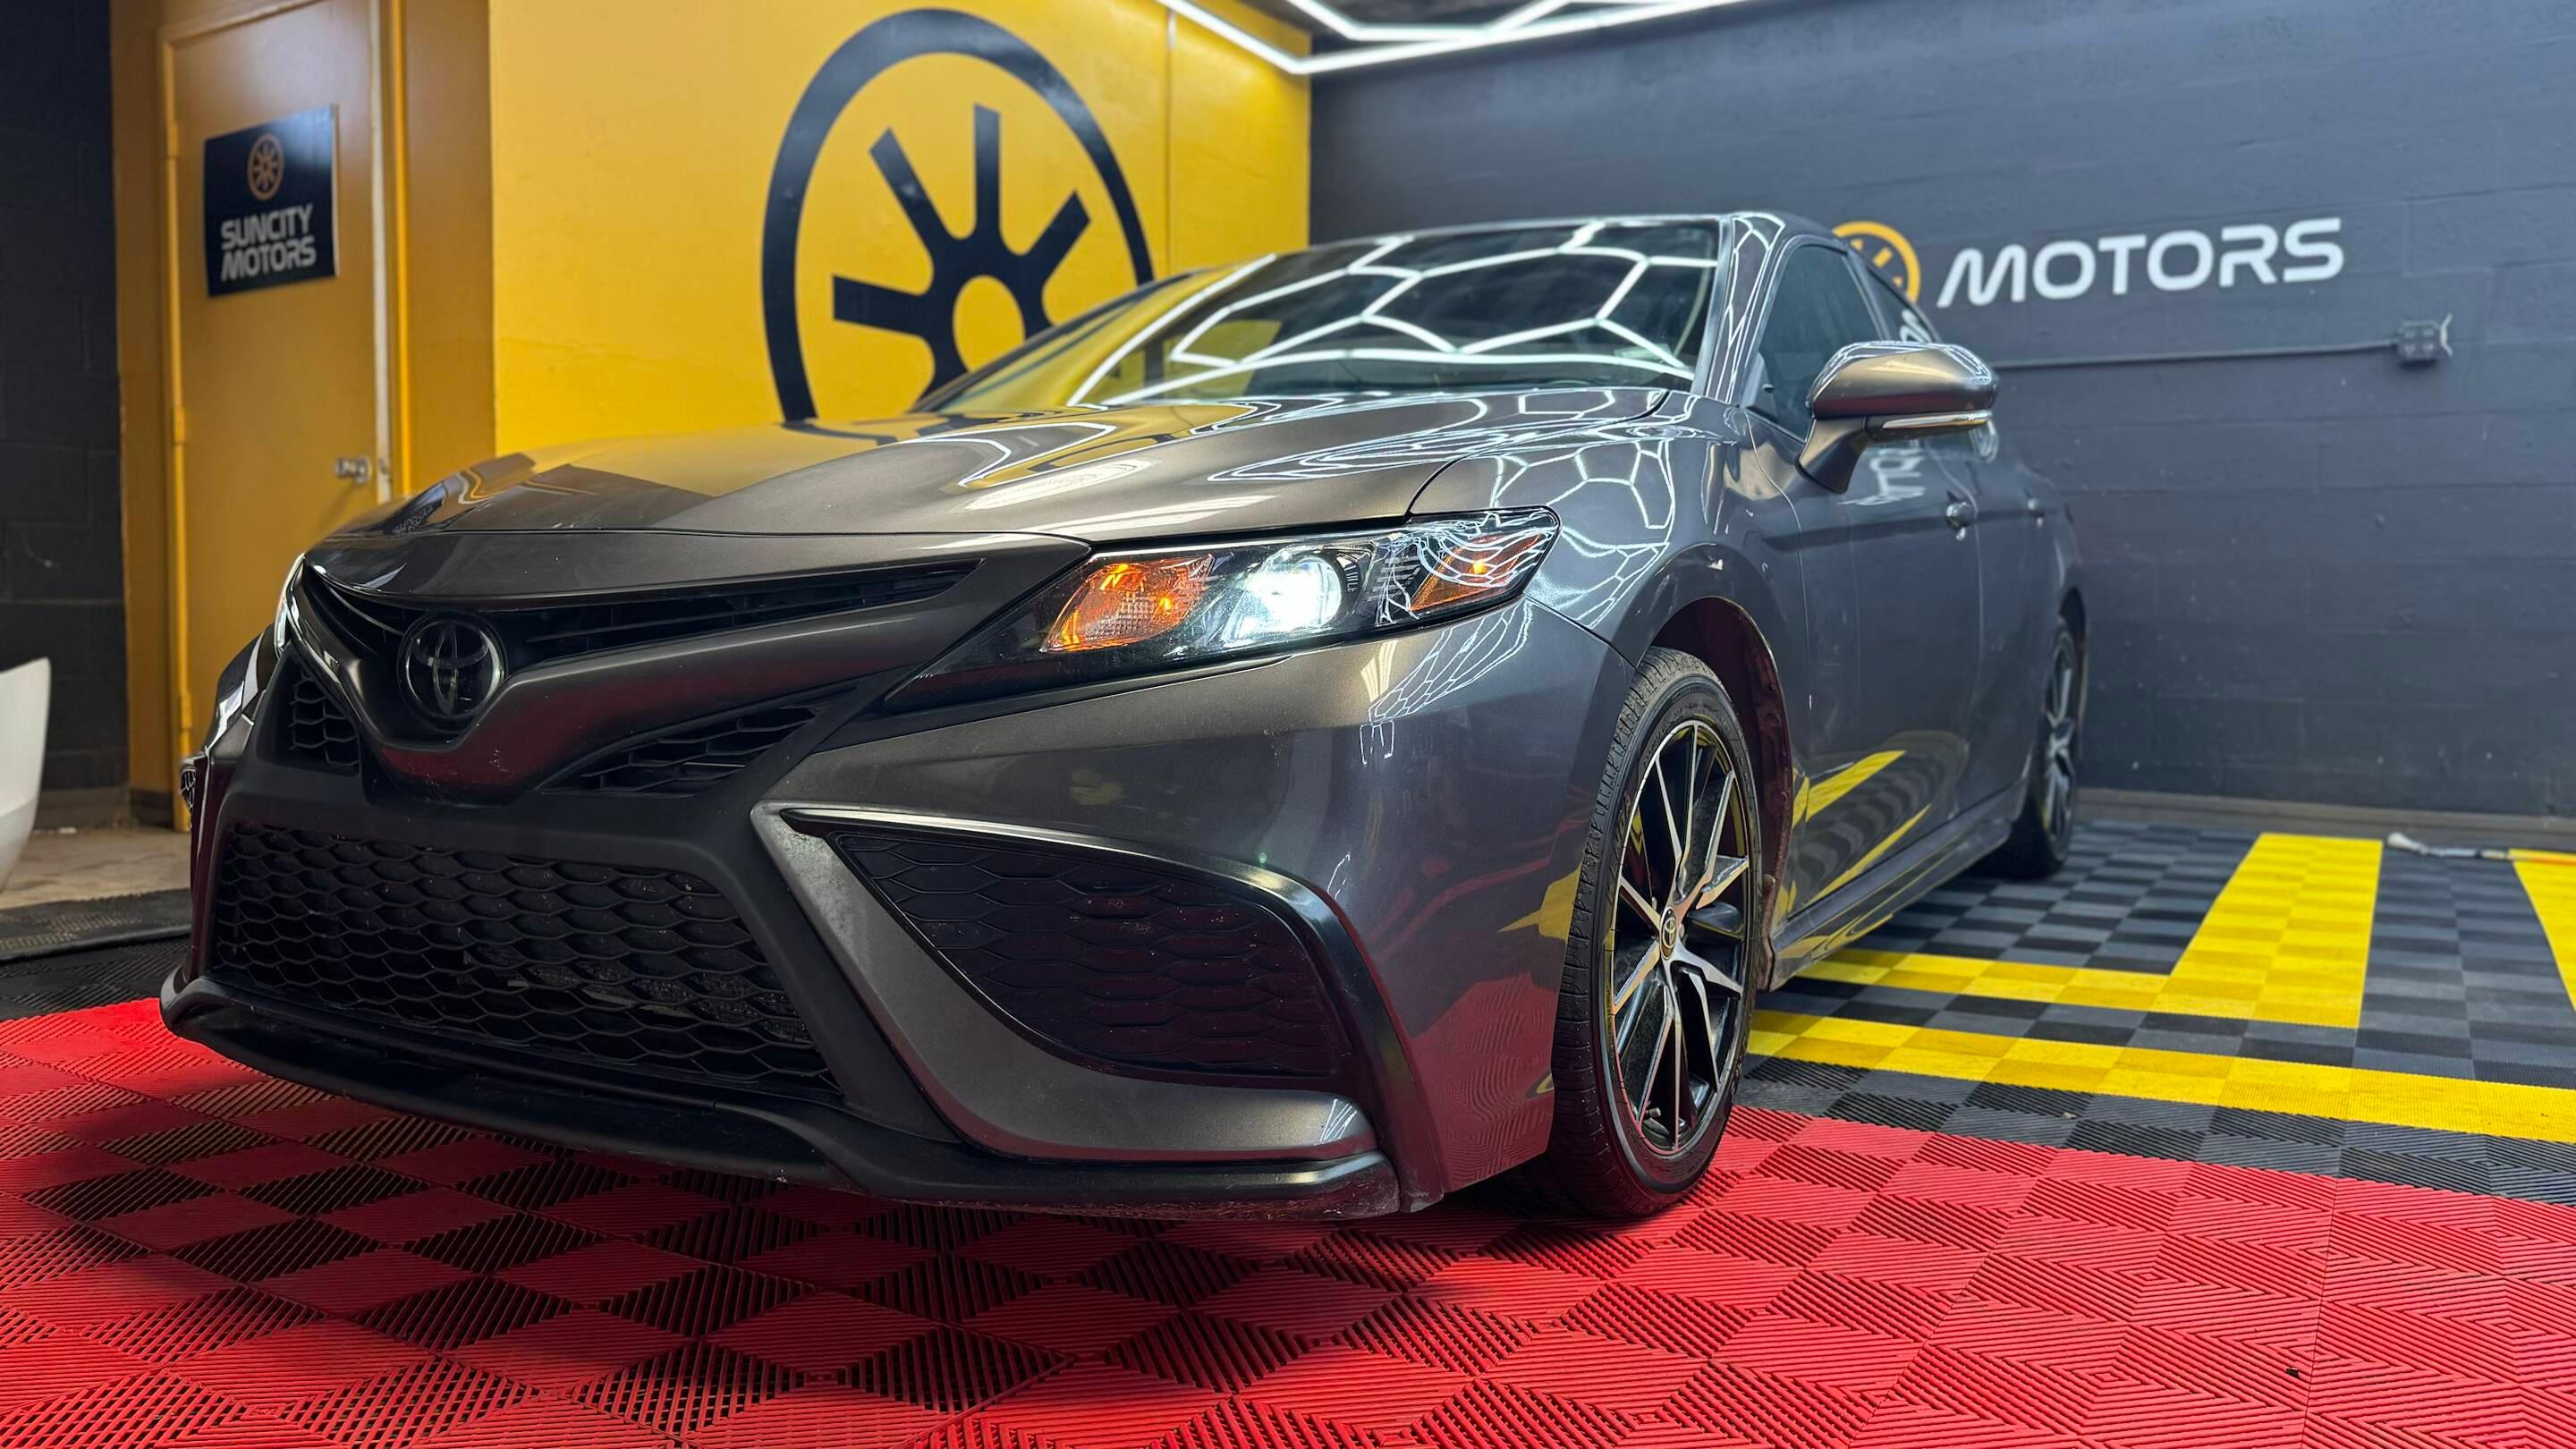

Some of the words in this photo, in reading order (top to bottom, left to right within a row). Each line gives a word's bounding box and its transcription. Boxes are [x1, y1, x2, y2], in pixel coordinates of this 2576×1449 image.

[221, 204, 313, 250] SUNCITY
[221, 235, 317, 281] MOTORS
[1936, 216, 2345, 309] MOTORS
